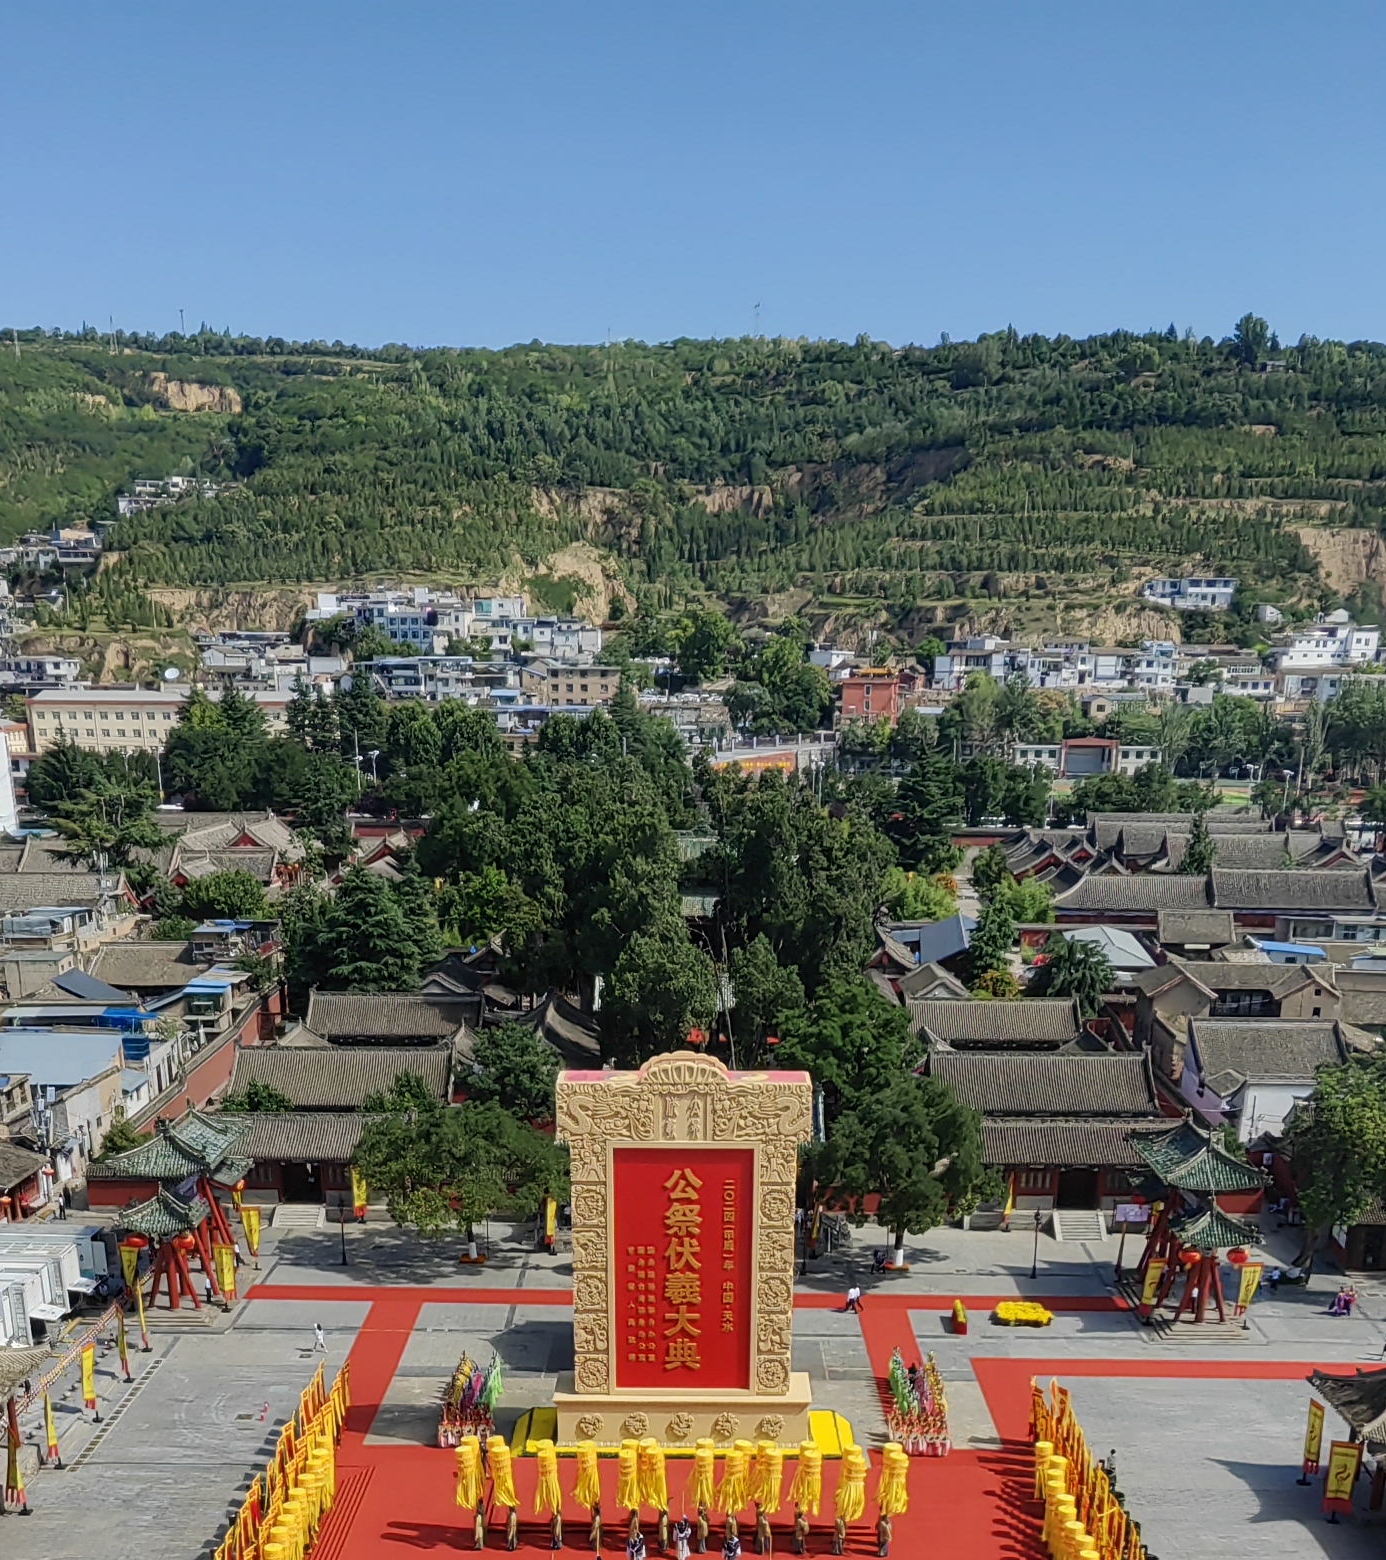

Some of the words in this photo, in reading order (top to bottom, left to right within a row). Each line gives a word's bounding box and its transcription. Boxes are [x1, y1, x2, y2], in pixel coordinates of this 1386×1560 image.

[664, 1167, 703, 1371] 公祭伏羲大典
